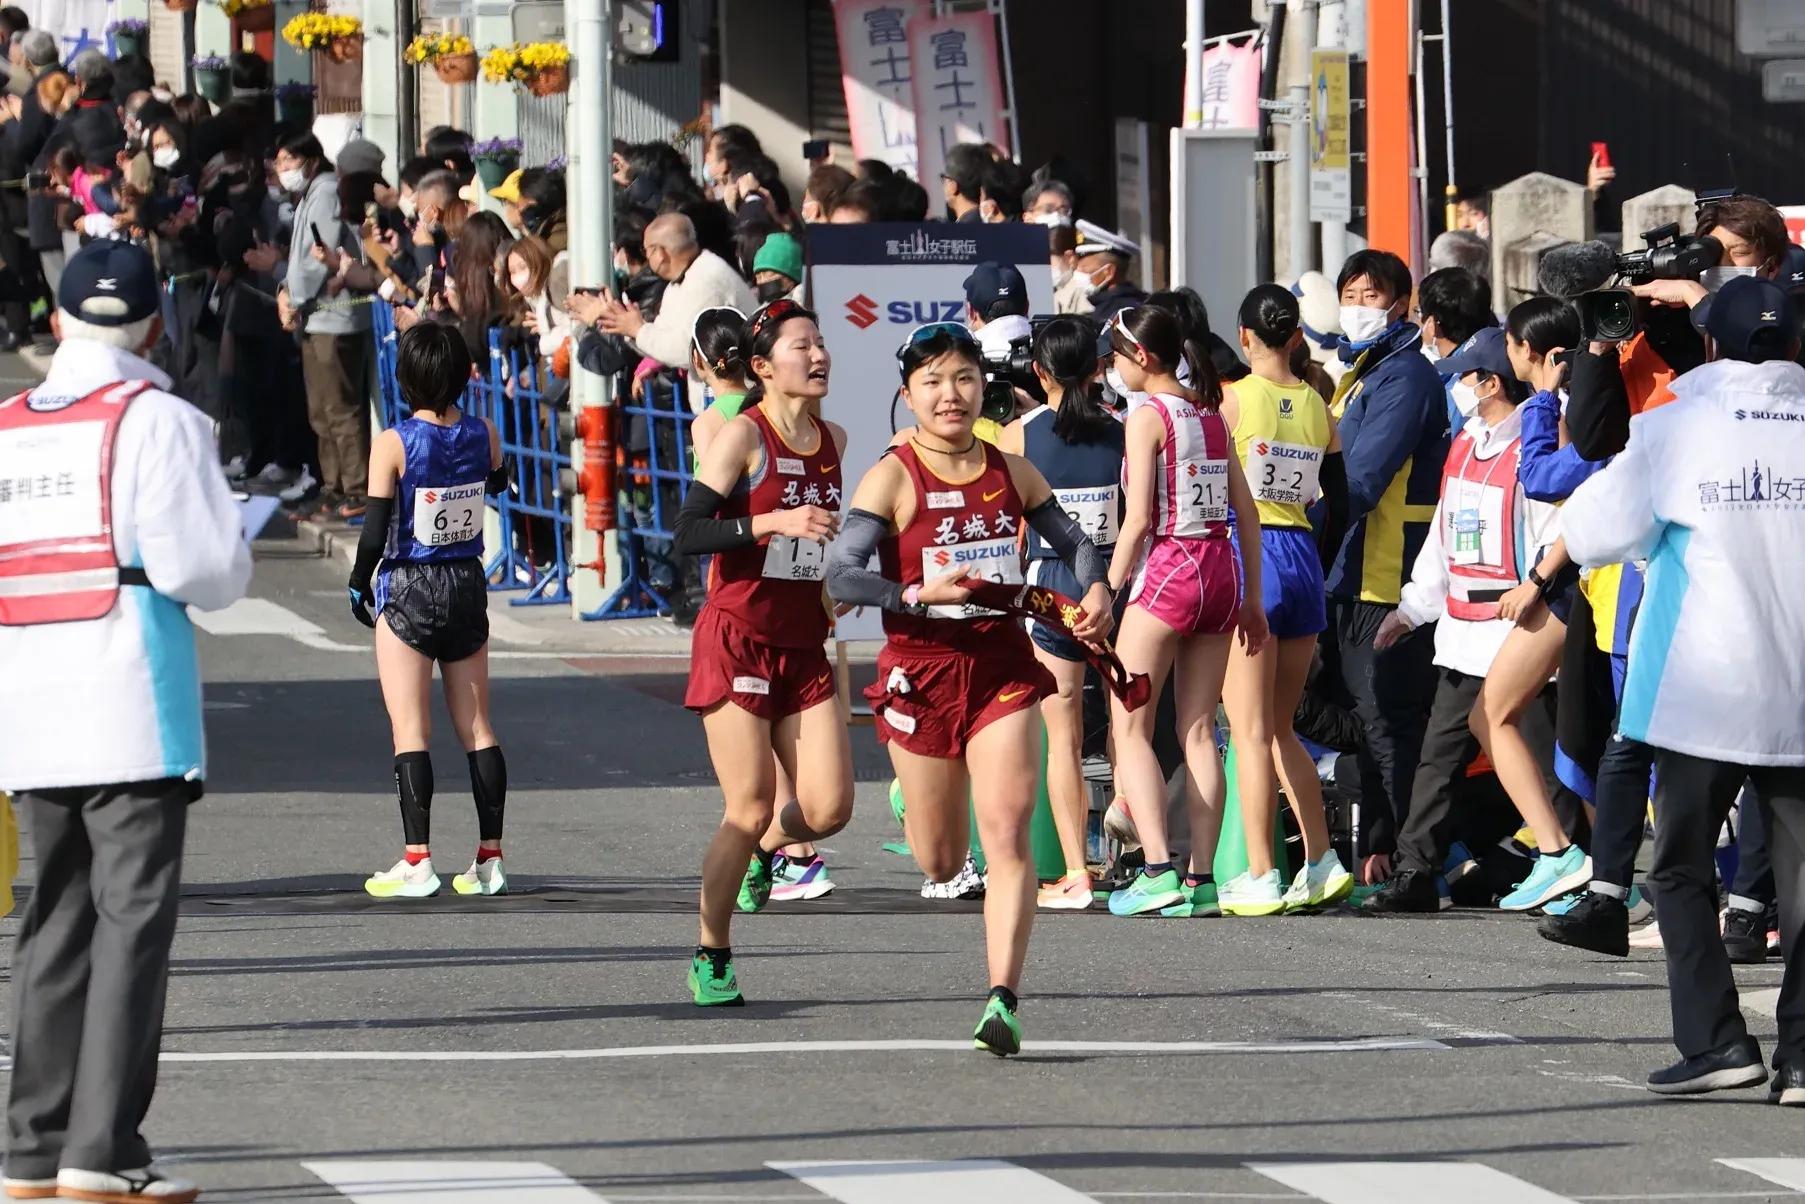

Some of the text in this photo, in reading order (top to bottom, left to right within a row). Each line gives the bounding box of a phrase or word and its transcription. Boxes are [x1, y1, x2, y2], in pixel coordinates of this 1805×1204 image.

[887, 301, 965, 324] SUZ
[1751, 411, 1805, 422] SUZUKI
[1271, 446, 1318, 462] SUZUKI
[1200, 464, 1227, 475] SUZU
[440, 487, 483, 502] SUZUKI
[781, 480, 841, 506] 名城大
[1060, 490, 1114, 503] SUZUKI
[1258, 487, 1303, 503] 大阪学院大
[432, 527, 474, 543] 日本体育大
[933, 509, 1017, 545] 名城大
[954, 543, 1015, 562] SUZUKI
[792, 565, 819, 578] 名城大
